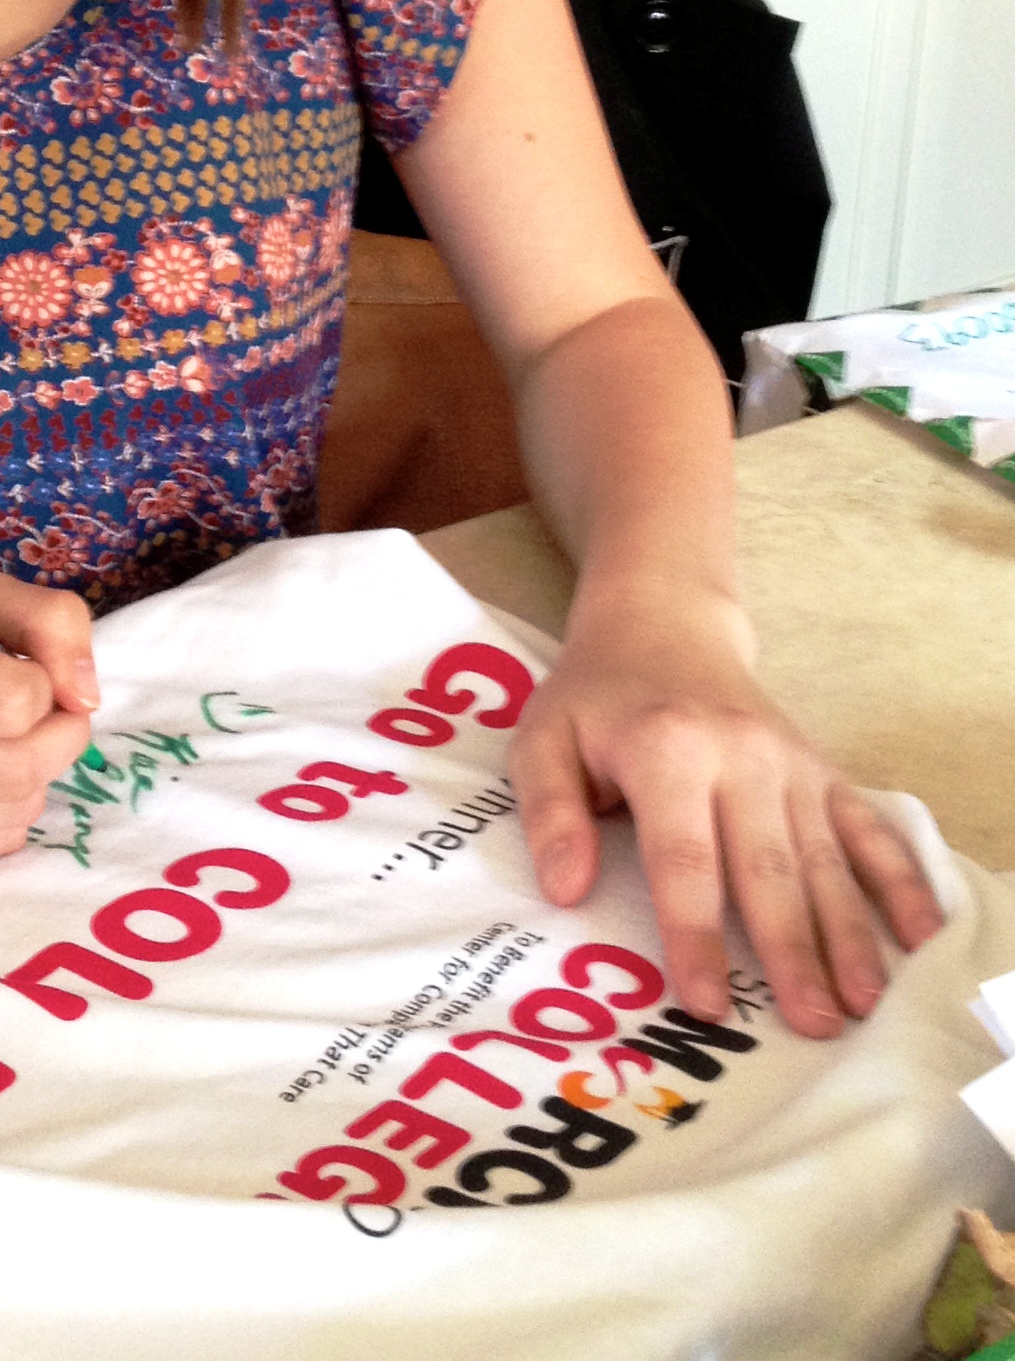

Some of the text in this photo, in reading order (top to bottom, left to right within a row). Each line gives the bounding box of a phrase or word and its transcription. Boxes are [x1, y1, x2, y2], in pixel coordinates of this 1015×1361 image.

[367, 642, 535, 747] Go
[256, 761, 409, 822] to
[461, 922, 516, 957] Center
[514, 931, 547, 947] To
[438, 955, 471, 984] for
[461, 945, 526, 1002] Benefit
[435, 999, 472, 1023] the
[255, 942, 665, 1206] COLLEG
[278, 1027, 367, 1103] That Care
[347, 1063, 373, 1085] of
